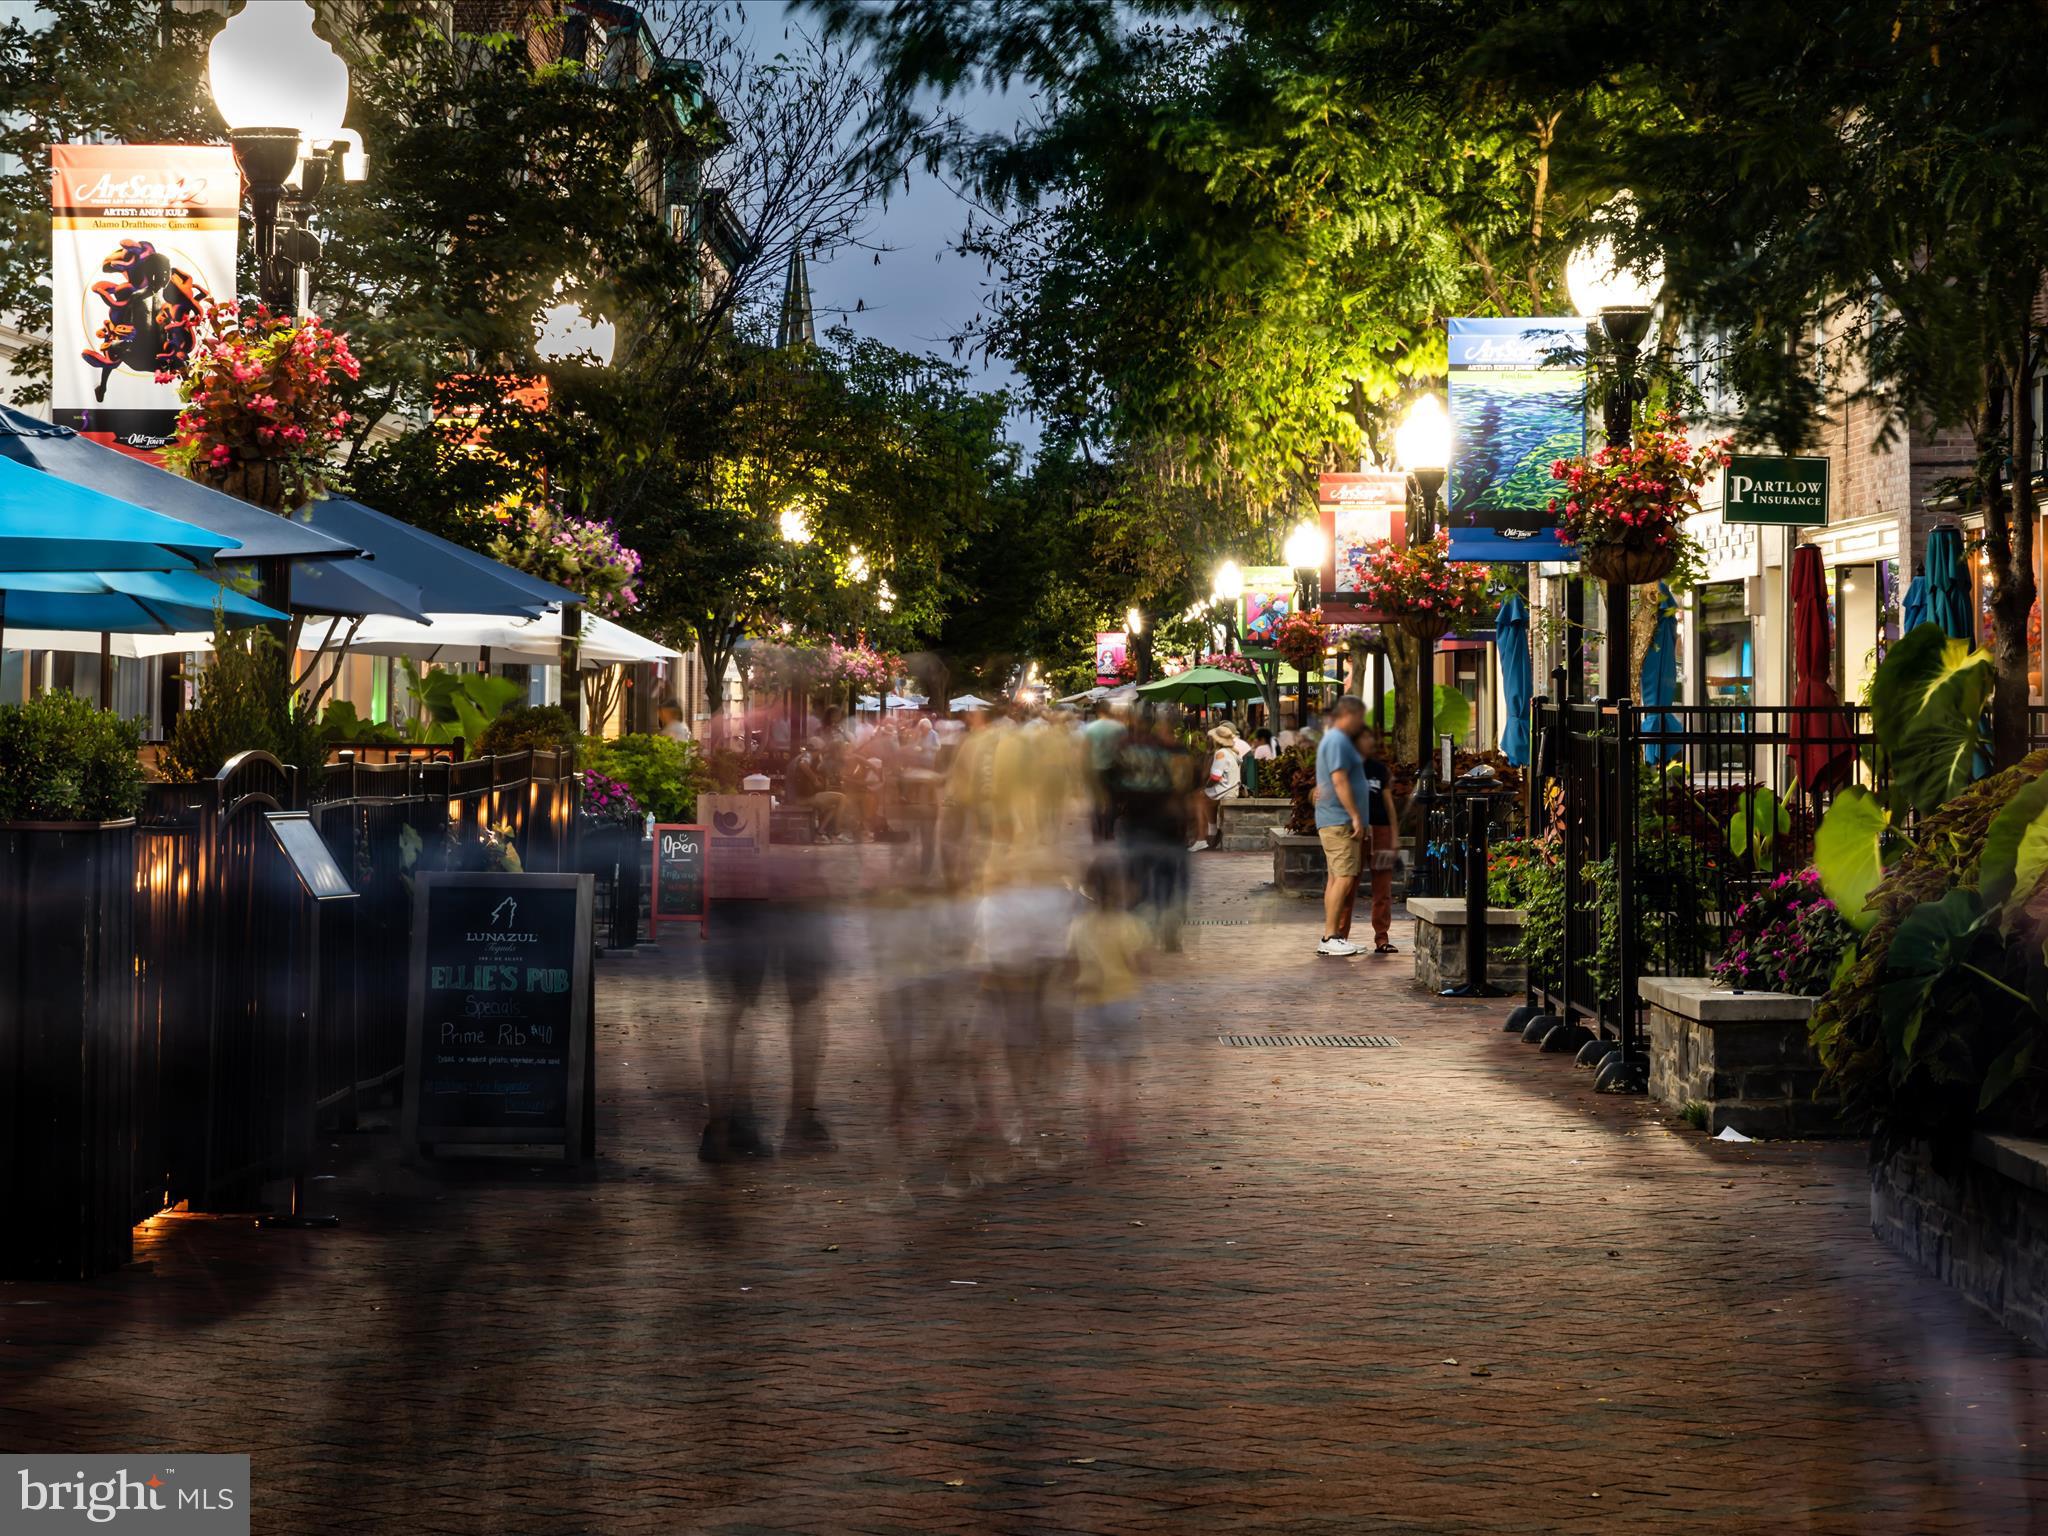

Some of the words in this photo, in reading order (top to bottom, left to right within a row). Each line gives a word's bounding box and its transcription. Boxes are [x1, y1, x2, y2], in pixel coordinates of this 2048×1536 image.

[103, 208, 138, 217] ARTIST:
[139, 208, 164, 217] ANDY
[165, 208, 189, 217] KULP
[92, 220, 120, 228] Alamo
[121, 220, 167, 229] Drafthouse
[168, 220, 199, 229] Cinema
[127, 432, 145, 445] Old
[142, 434, 165, 446] Town
[1730, 475, 1822, 503] PARTLOW
[1752, 492, 1822, 506] INSURANCE
[1503, 527, 1517, 537] Old
[1515, 529, 1532, 538] Town
[663, 834, 698, 859] Open
[466, 932, 538, 943] LUNAZUL
[431, 964, 518, 992] ELLIE'S
[526, 967, 570, 994] PUB
[464, 994, 521, 1019] Specials
[440, 1022, 486, 1046] Prime
[497, 1022, 526, 1046] Rib
[530, 1023, 553, 1045] $40
